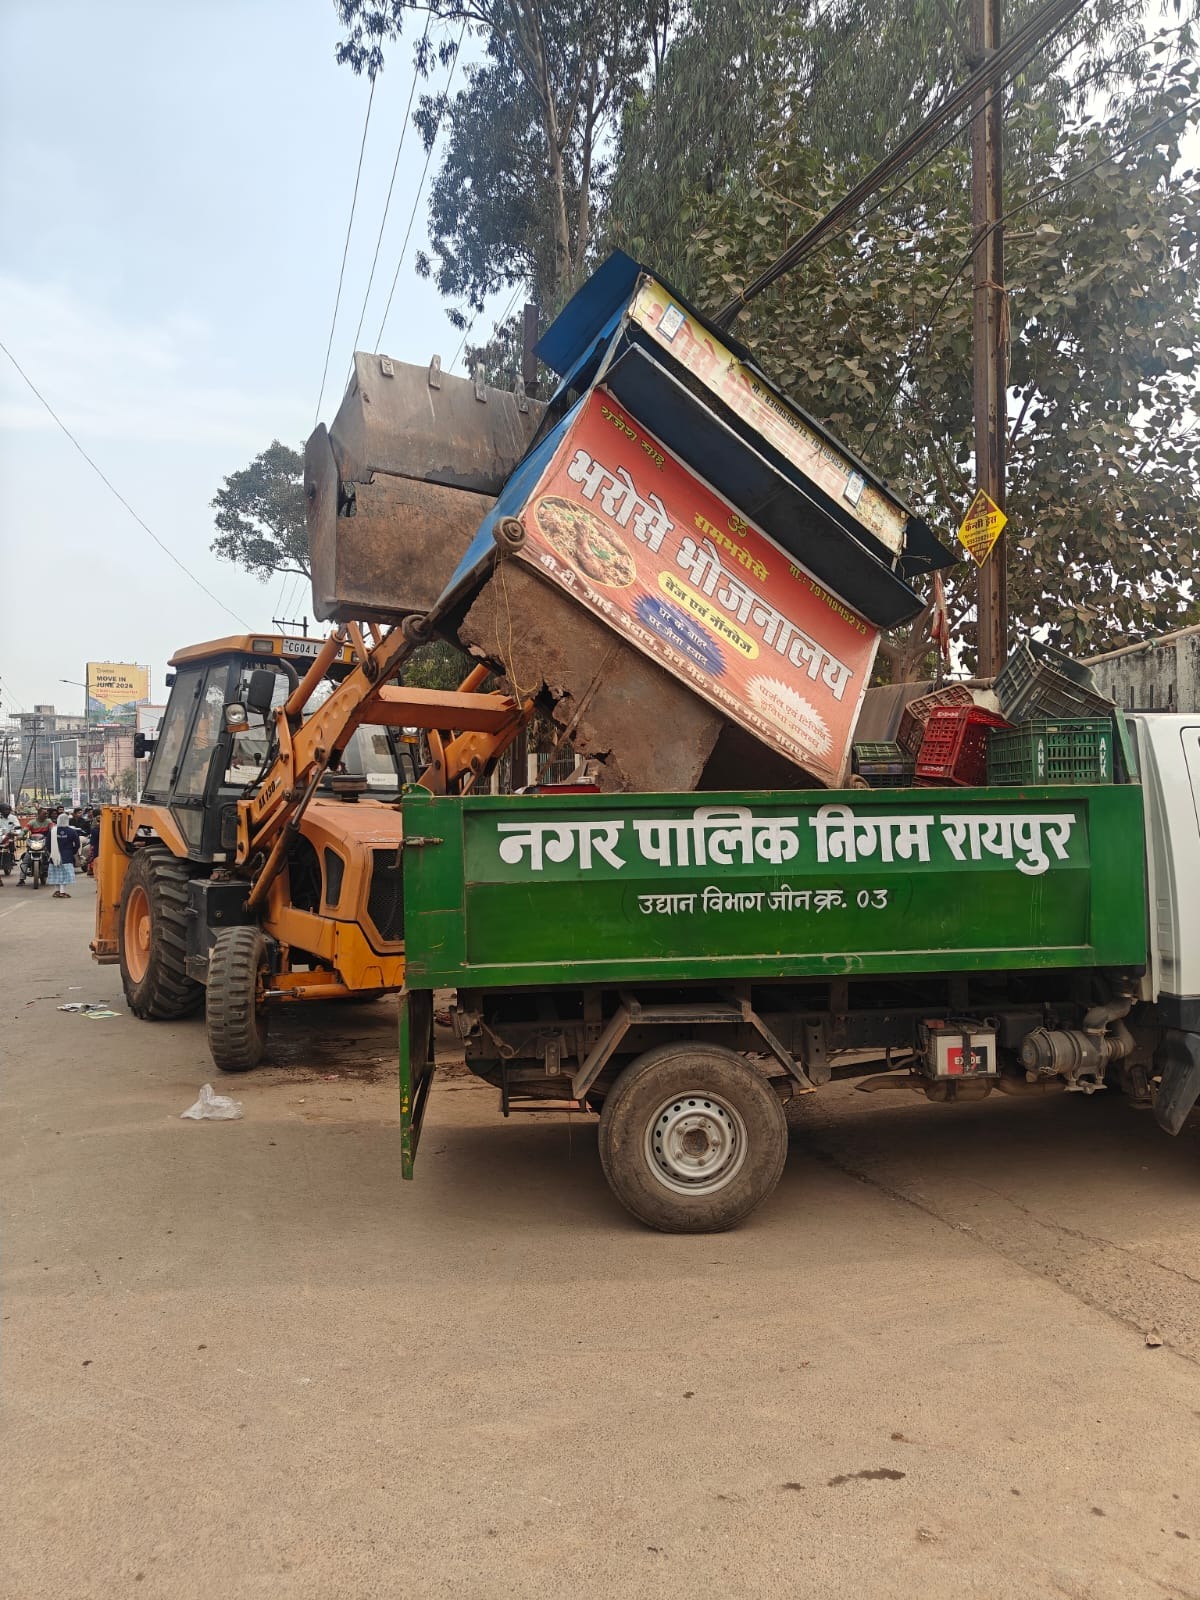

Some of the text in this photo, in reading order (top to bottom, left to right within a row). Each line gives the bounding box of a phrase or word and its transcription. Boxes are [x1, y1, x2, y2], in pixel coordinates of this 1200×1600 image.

[567, 448, 852, 702] भरोसे भोजनालय
[693, 512, 771, 583] रामभरोसे
[497, 804, 1077, 876] नगर पालिक निगम रायपुर
[637, 894, 698, 917] उद्यान
[701, 886, 766, 914] विभाग
[813, 889, 848, 914] क्र.
[856, 889, 888, 910] 03
[954, 1056, 981, 1065] EDE
